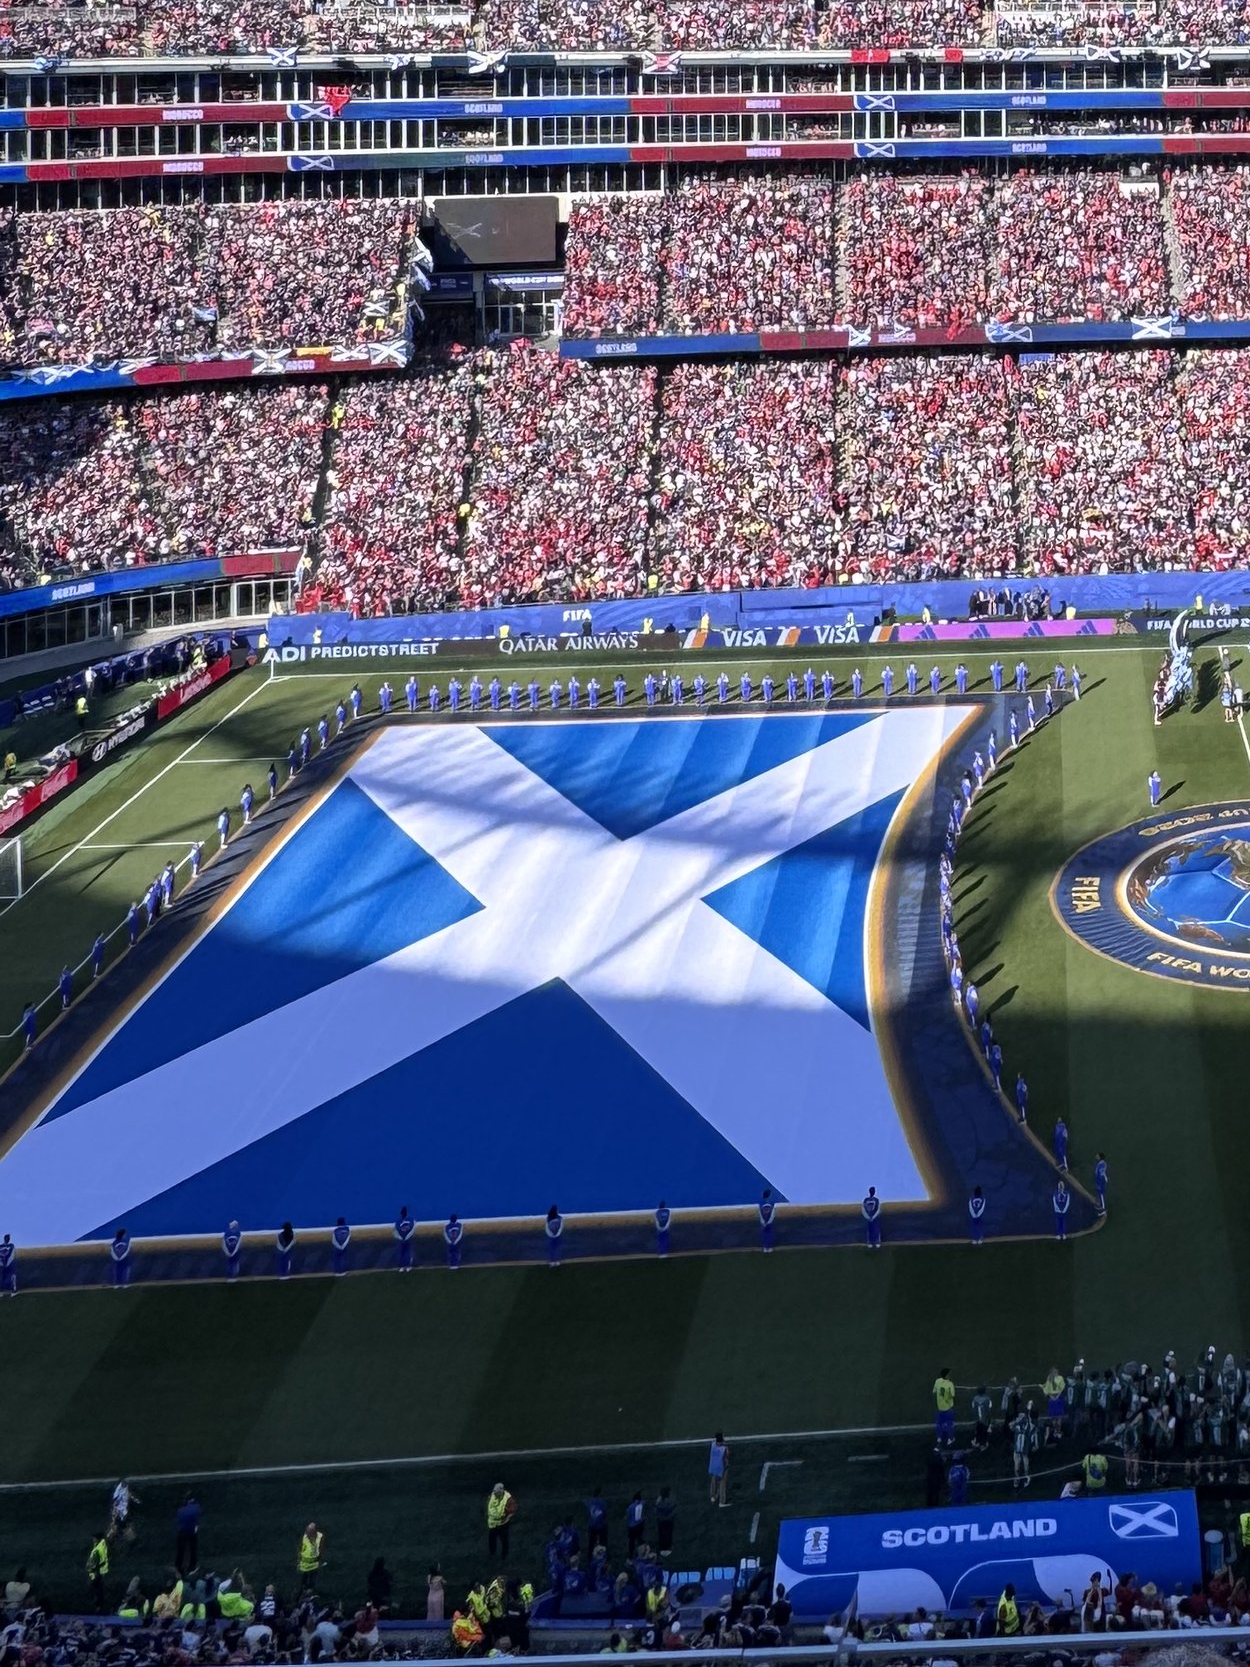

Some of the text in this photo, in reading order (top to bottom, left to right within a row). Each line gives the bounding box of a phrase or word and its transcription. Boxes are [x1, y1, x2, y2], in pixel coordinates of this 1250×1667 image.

[562, 609, 593, 622] FIFA
[1216, 618, 1240, 629] CUP
[499, 632, 640, 655] QATAR AIRWAYS
[722, 629, 767, 647] VISA
[814, 626, 860, 644] VISA
[311, 642, 440, 660] PREDICTSTREET
[1071, 877, 1102, 914] FIFA
[1147, 951, 1202, 974] FIFA
[881, 1518, 1057, 1549] SCOTLAND
